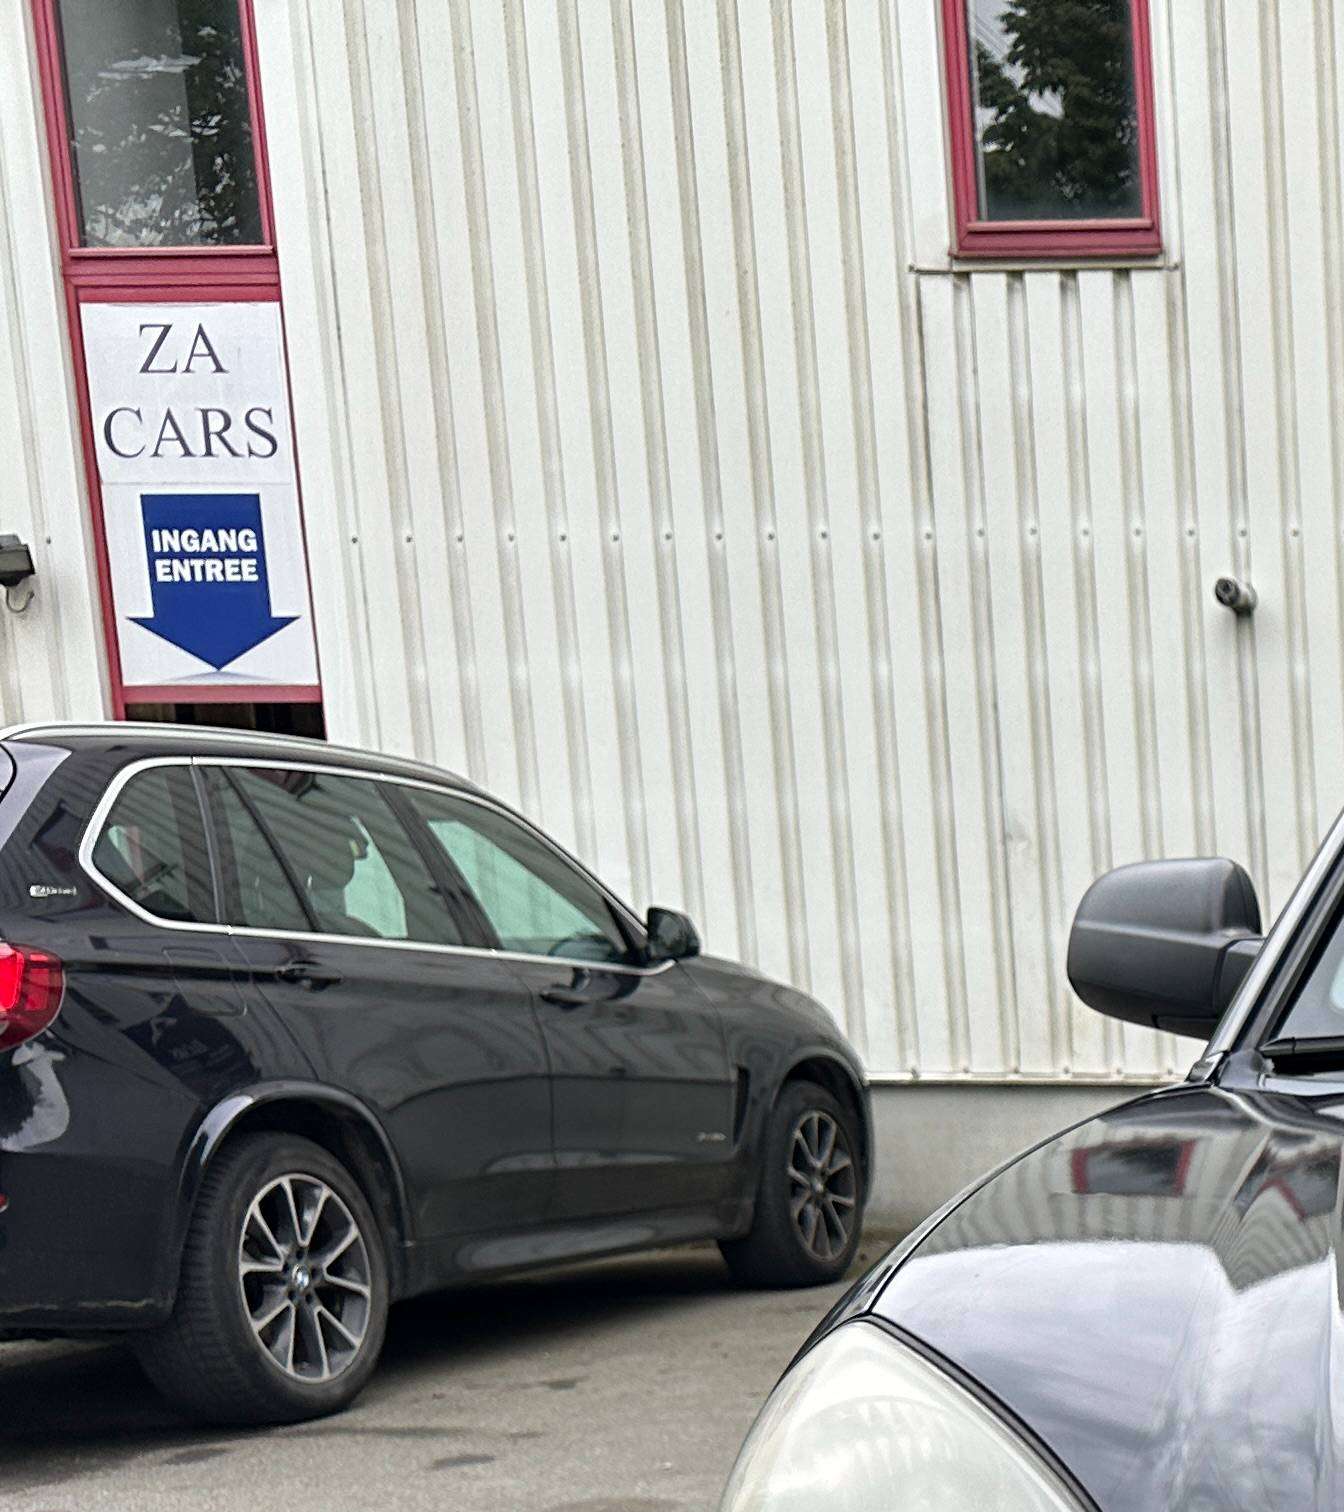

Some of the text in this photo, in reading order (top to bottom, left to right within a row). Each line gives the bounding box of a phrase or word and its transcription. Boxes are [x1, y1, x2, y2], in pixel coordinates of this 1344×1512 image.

[139, 322, 230, 374] ZA
[103, 406, 279, 460] CARS
[151, 528, 258, 554] INGANG
[155, 558, 259, 582] ENTREE
